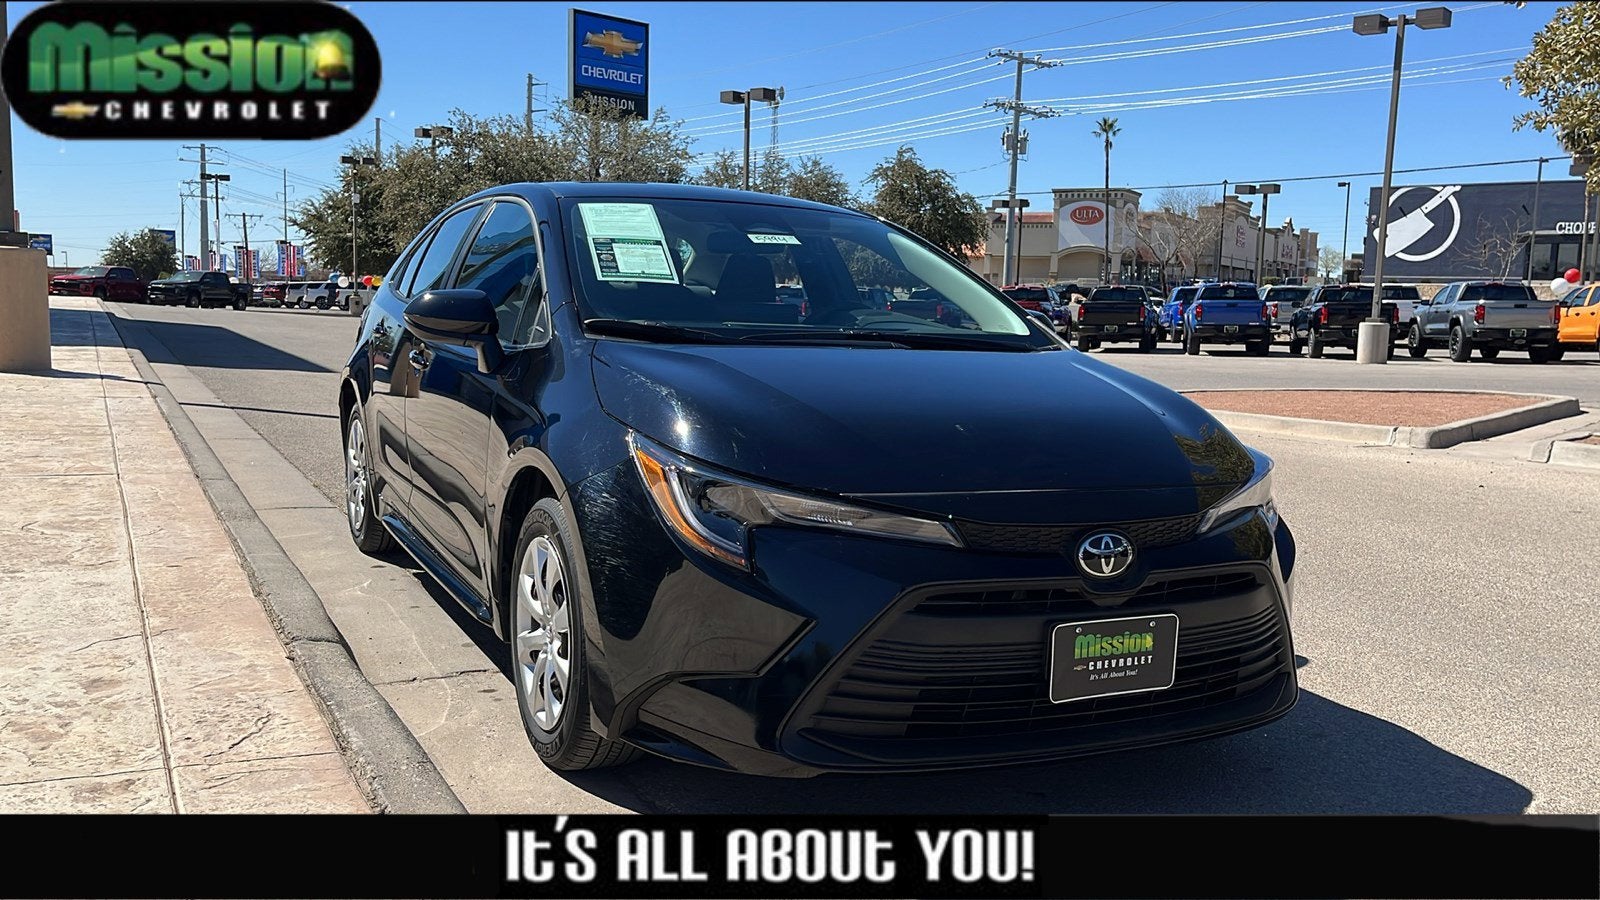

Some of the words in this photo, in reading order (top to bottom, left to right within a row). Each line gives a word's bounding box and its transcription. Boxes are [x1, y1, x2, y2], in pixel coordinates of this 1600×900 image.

[581, 65, 643, 85] CHEVROLET
[590, 94, 635, 111] MISSION
[1075, 209, 1100, 219] ULTA
[1074, 631, 1154, 660] Mission
[1088, 655, 1153, 671] CHEVROLET
[1089, 673, 1099, 681] It's
[1100, 671, 1109, 680] All
[1109, 670, 1126, 679] About
[1126, 668, 1139, 677] You!
